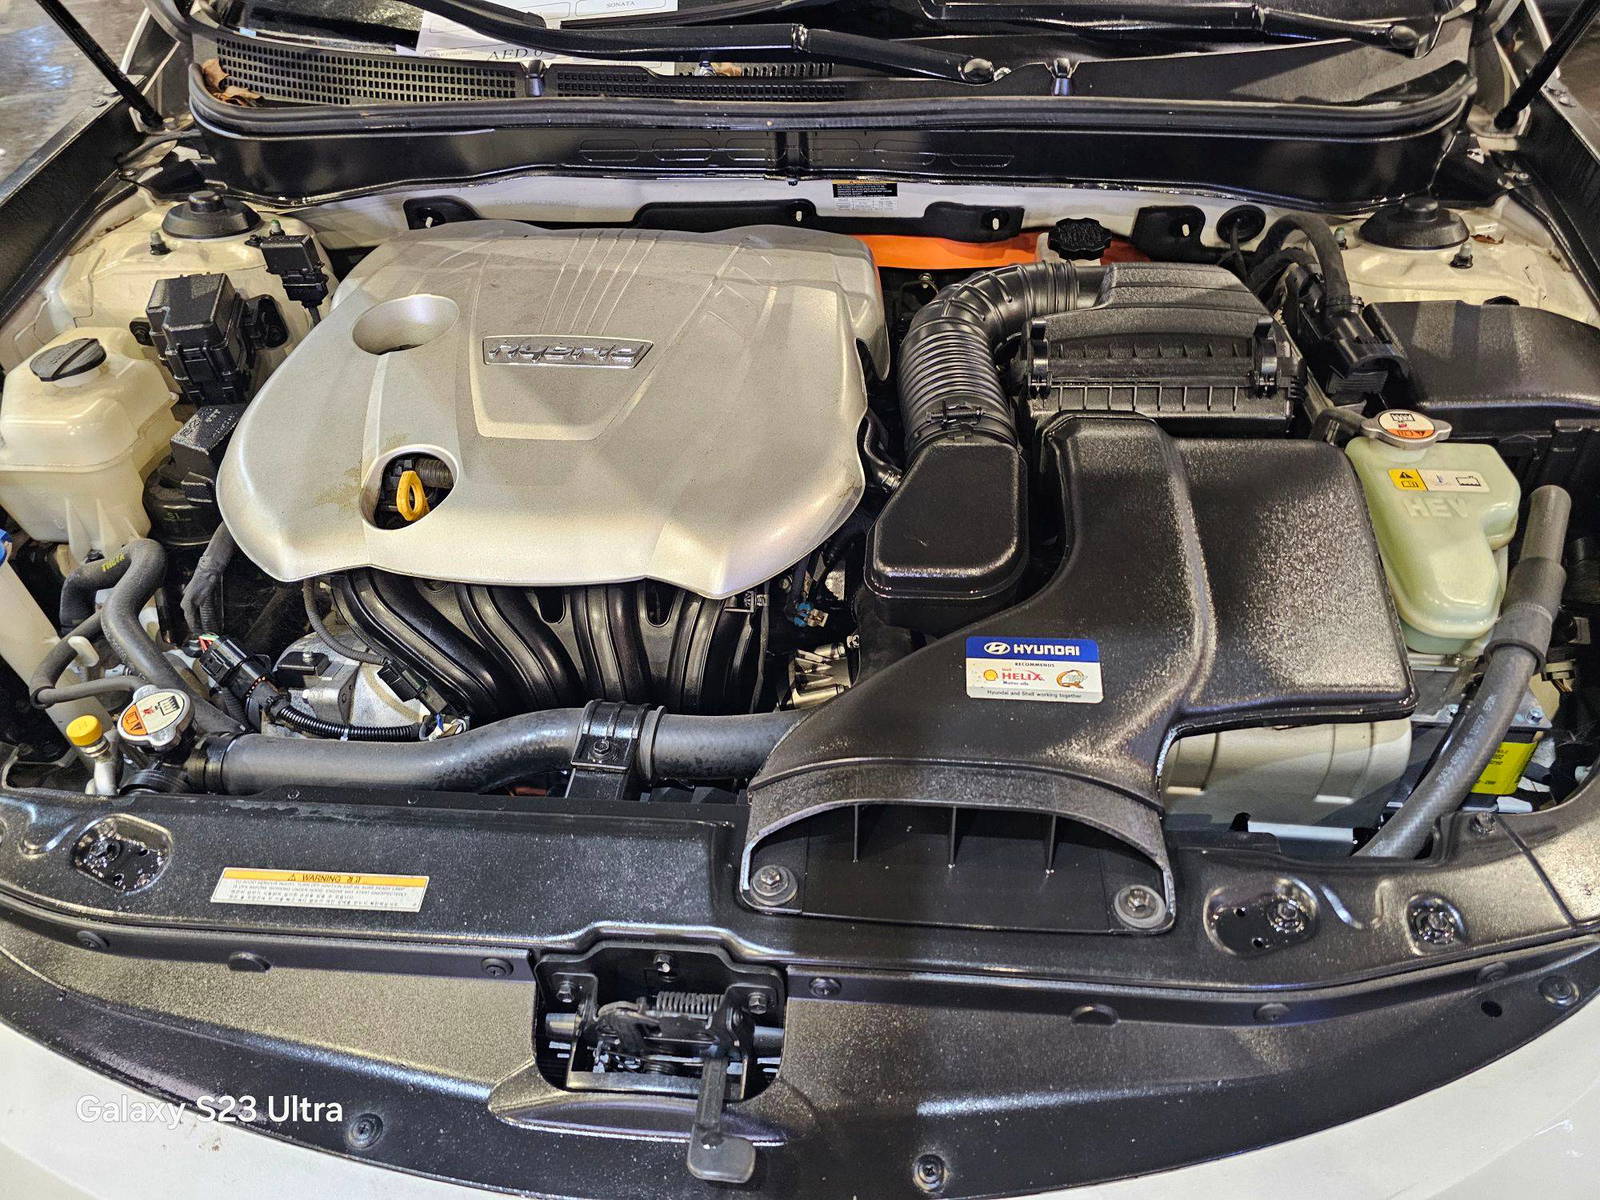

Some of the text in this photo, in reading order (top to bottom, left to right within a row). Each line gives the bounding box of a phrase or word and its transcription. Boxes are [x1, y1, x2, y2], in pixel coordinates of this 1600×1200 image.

[487, 48, 529, 61] AED
[1402, 497, 1469, 518] HEV
[1013, 643, 1080, 656] HYUNDAI
[1002, 671, 1045, 682] HELIX
[302, 873, 341, 883] WARNING
